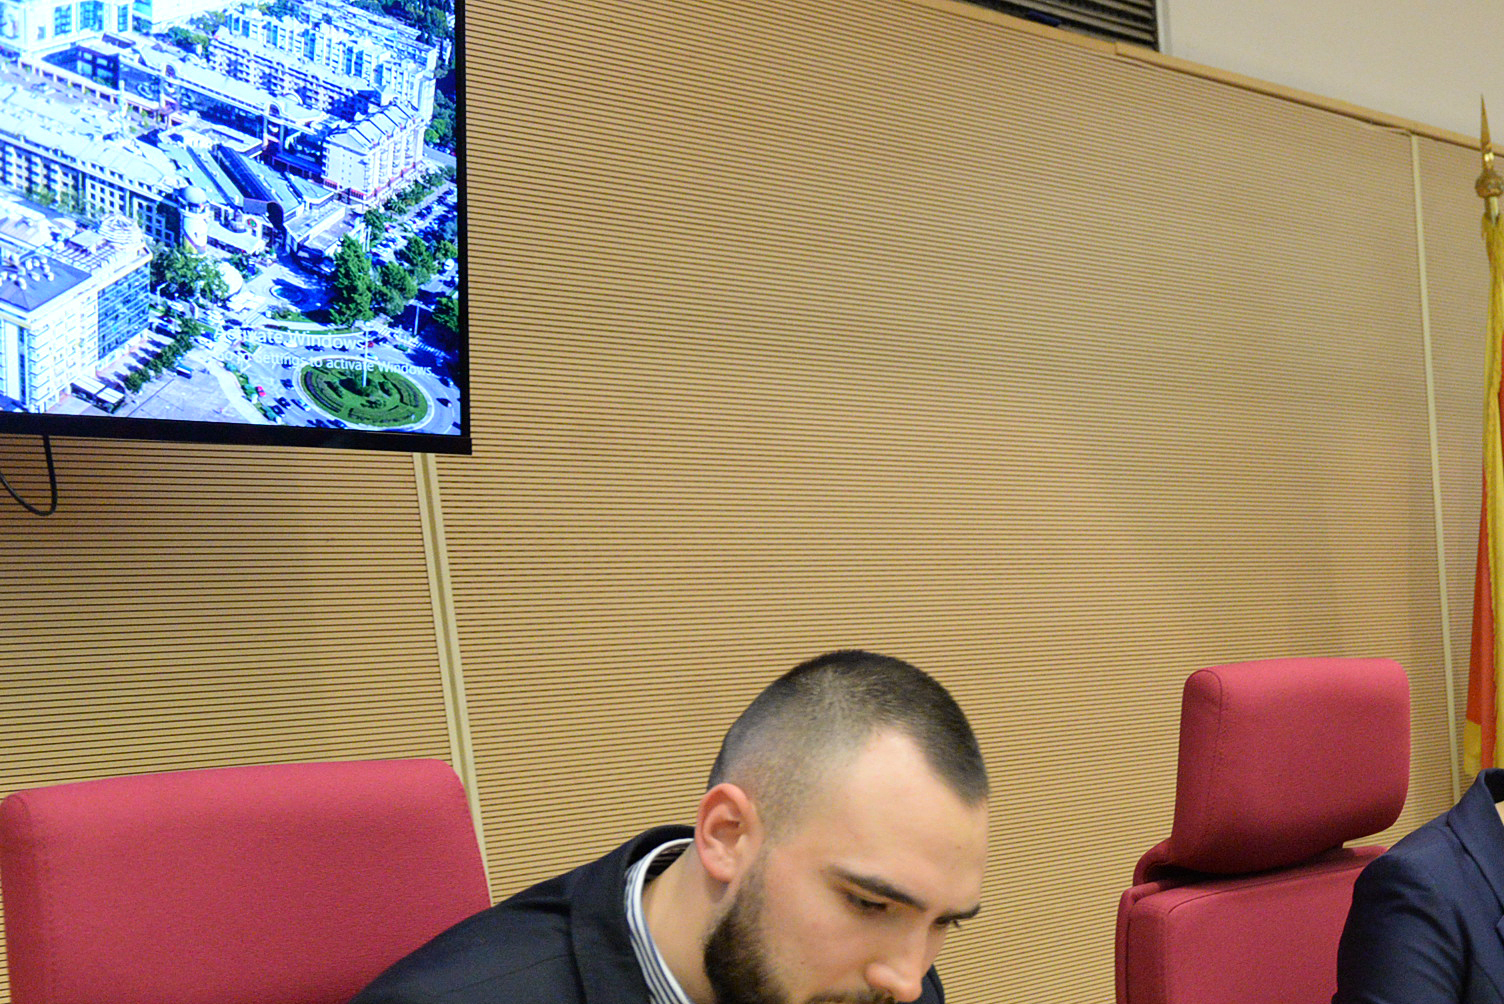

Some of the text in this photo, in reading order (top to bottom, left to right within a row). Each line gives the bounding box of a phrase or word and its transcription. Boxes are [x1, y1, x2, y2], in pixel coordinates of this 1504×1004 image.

[288, 330, 365, 350] Windows
[310, 356, 323, 367] to
[326, 358, 374, 371] activate
